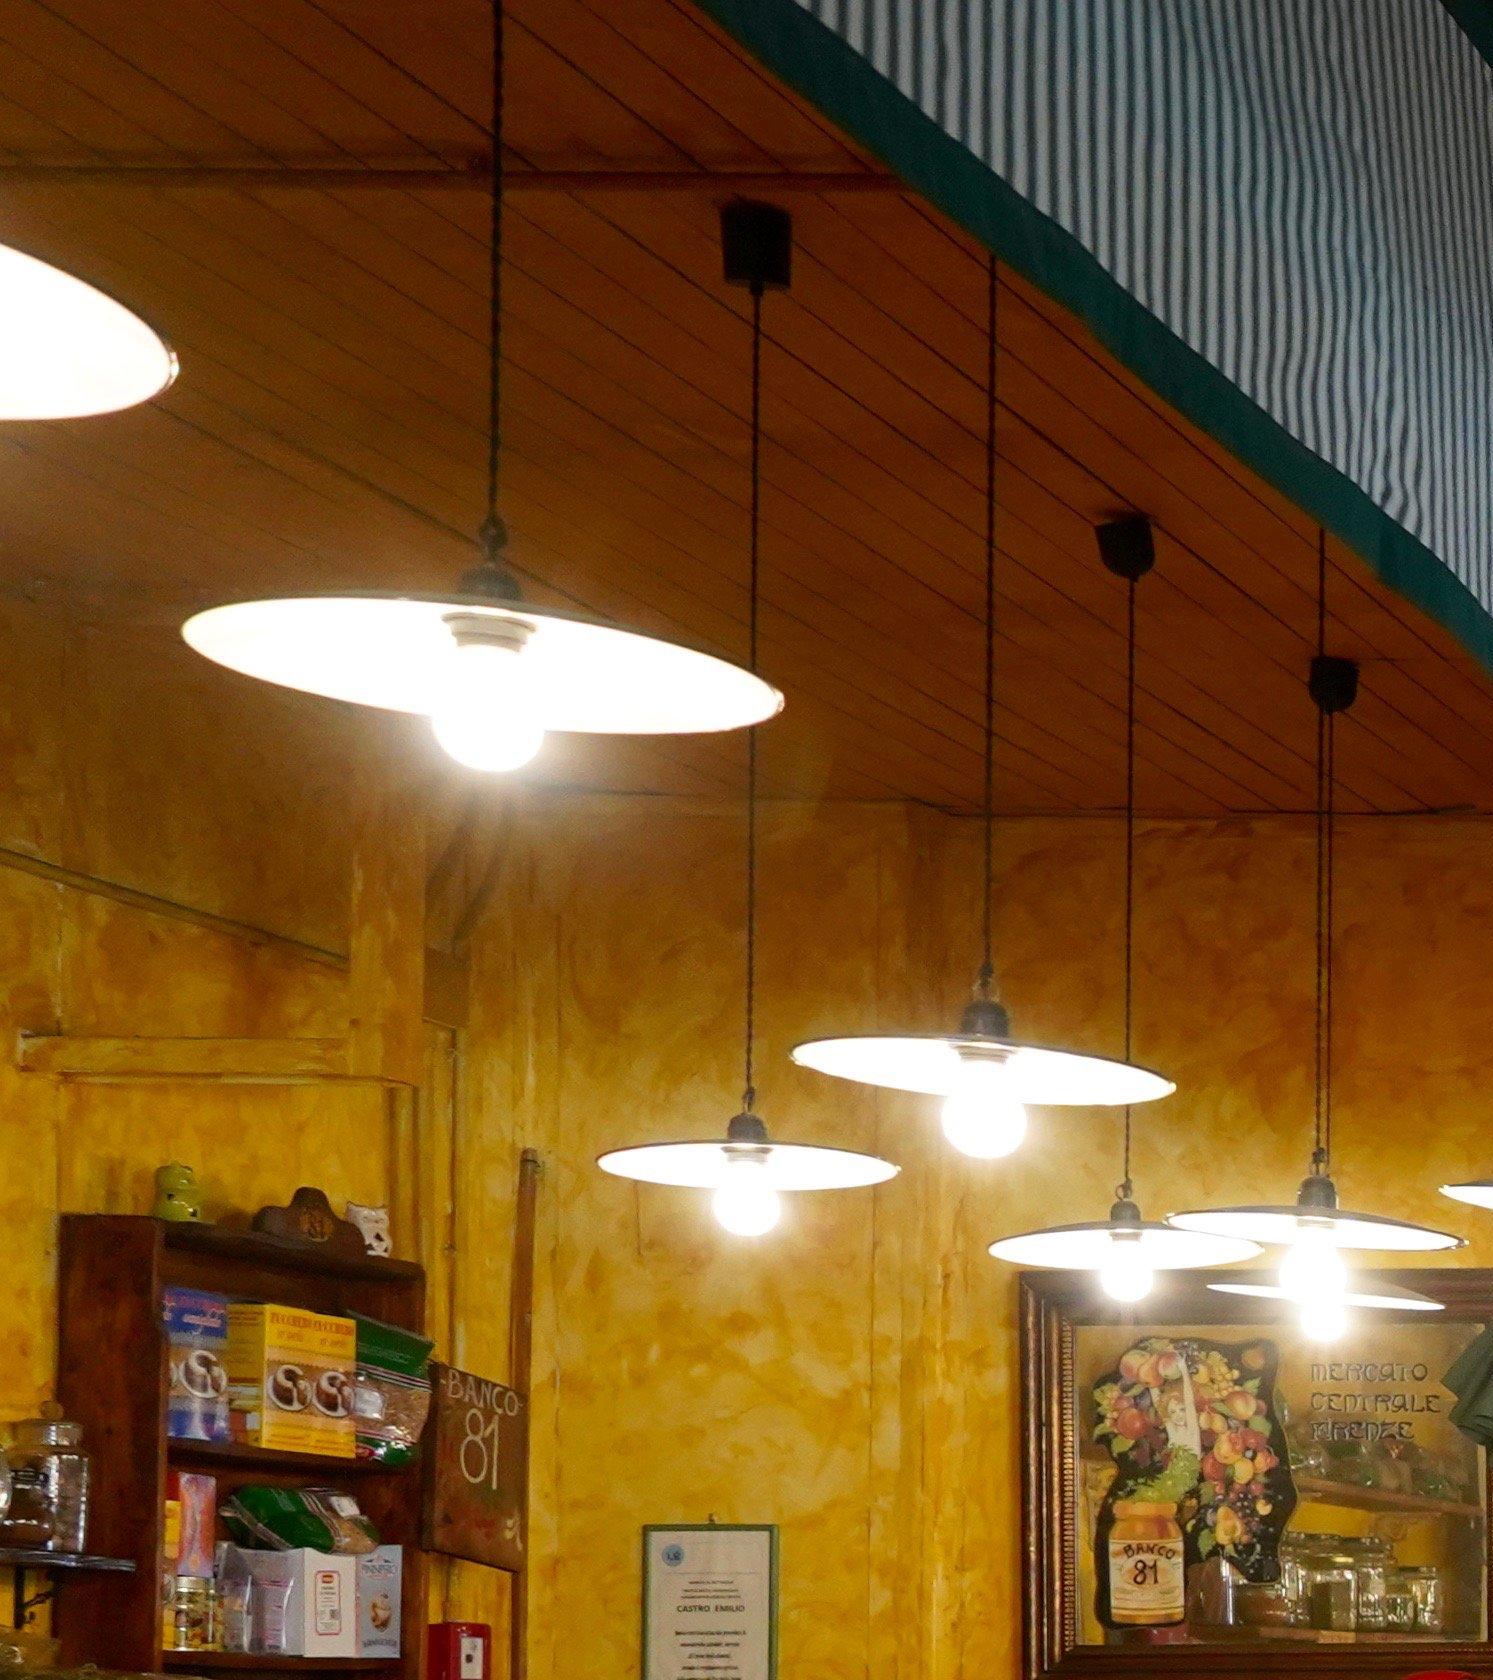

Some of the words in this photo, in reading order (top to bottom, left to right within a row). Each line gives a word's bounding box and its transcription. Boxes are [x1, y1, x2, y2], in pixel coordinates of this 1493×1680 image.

[1311, 1362, 1429, 1383] MERCATO
[1310, 1392, 1441, 1414] CENTRALE
[1311, 1420, 1415, 1442] FIRENZE
[460, 1407, 498, 1491] 81
[1123, 1543, 1177, 1560] BANCO
[1132, 1559, 1159, 1586] 81
[677, 1604, 711, 1613] CASTRO
